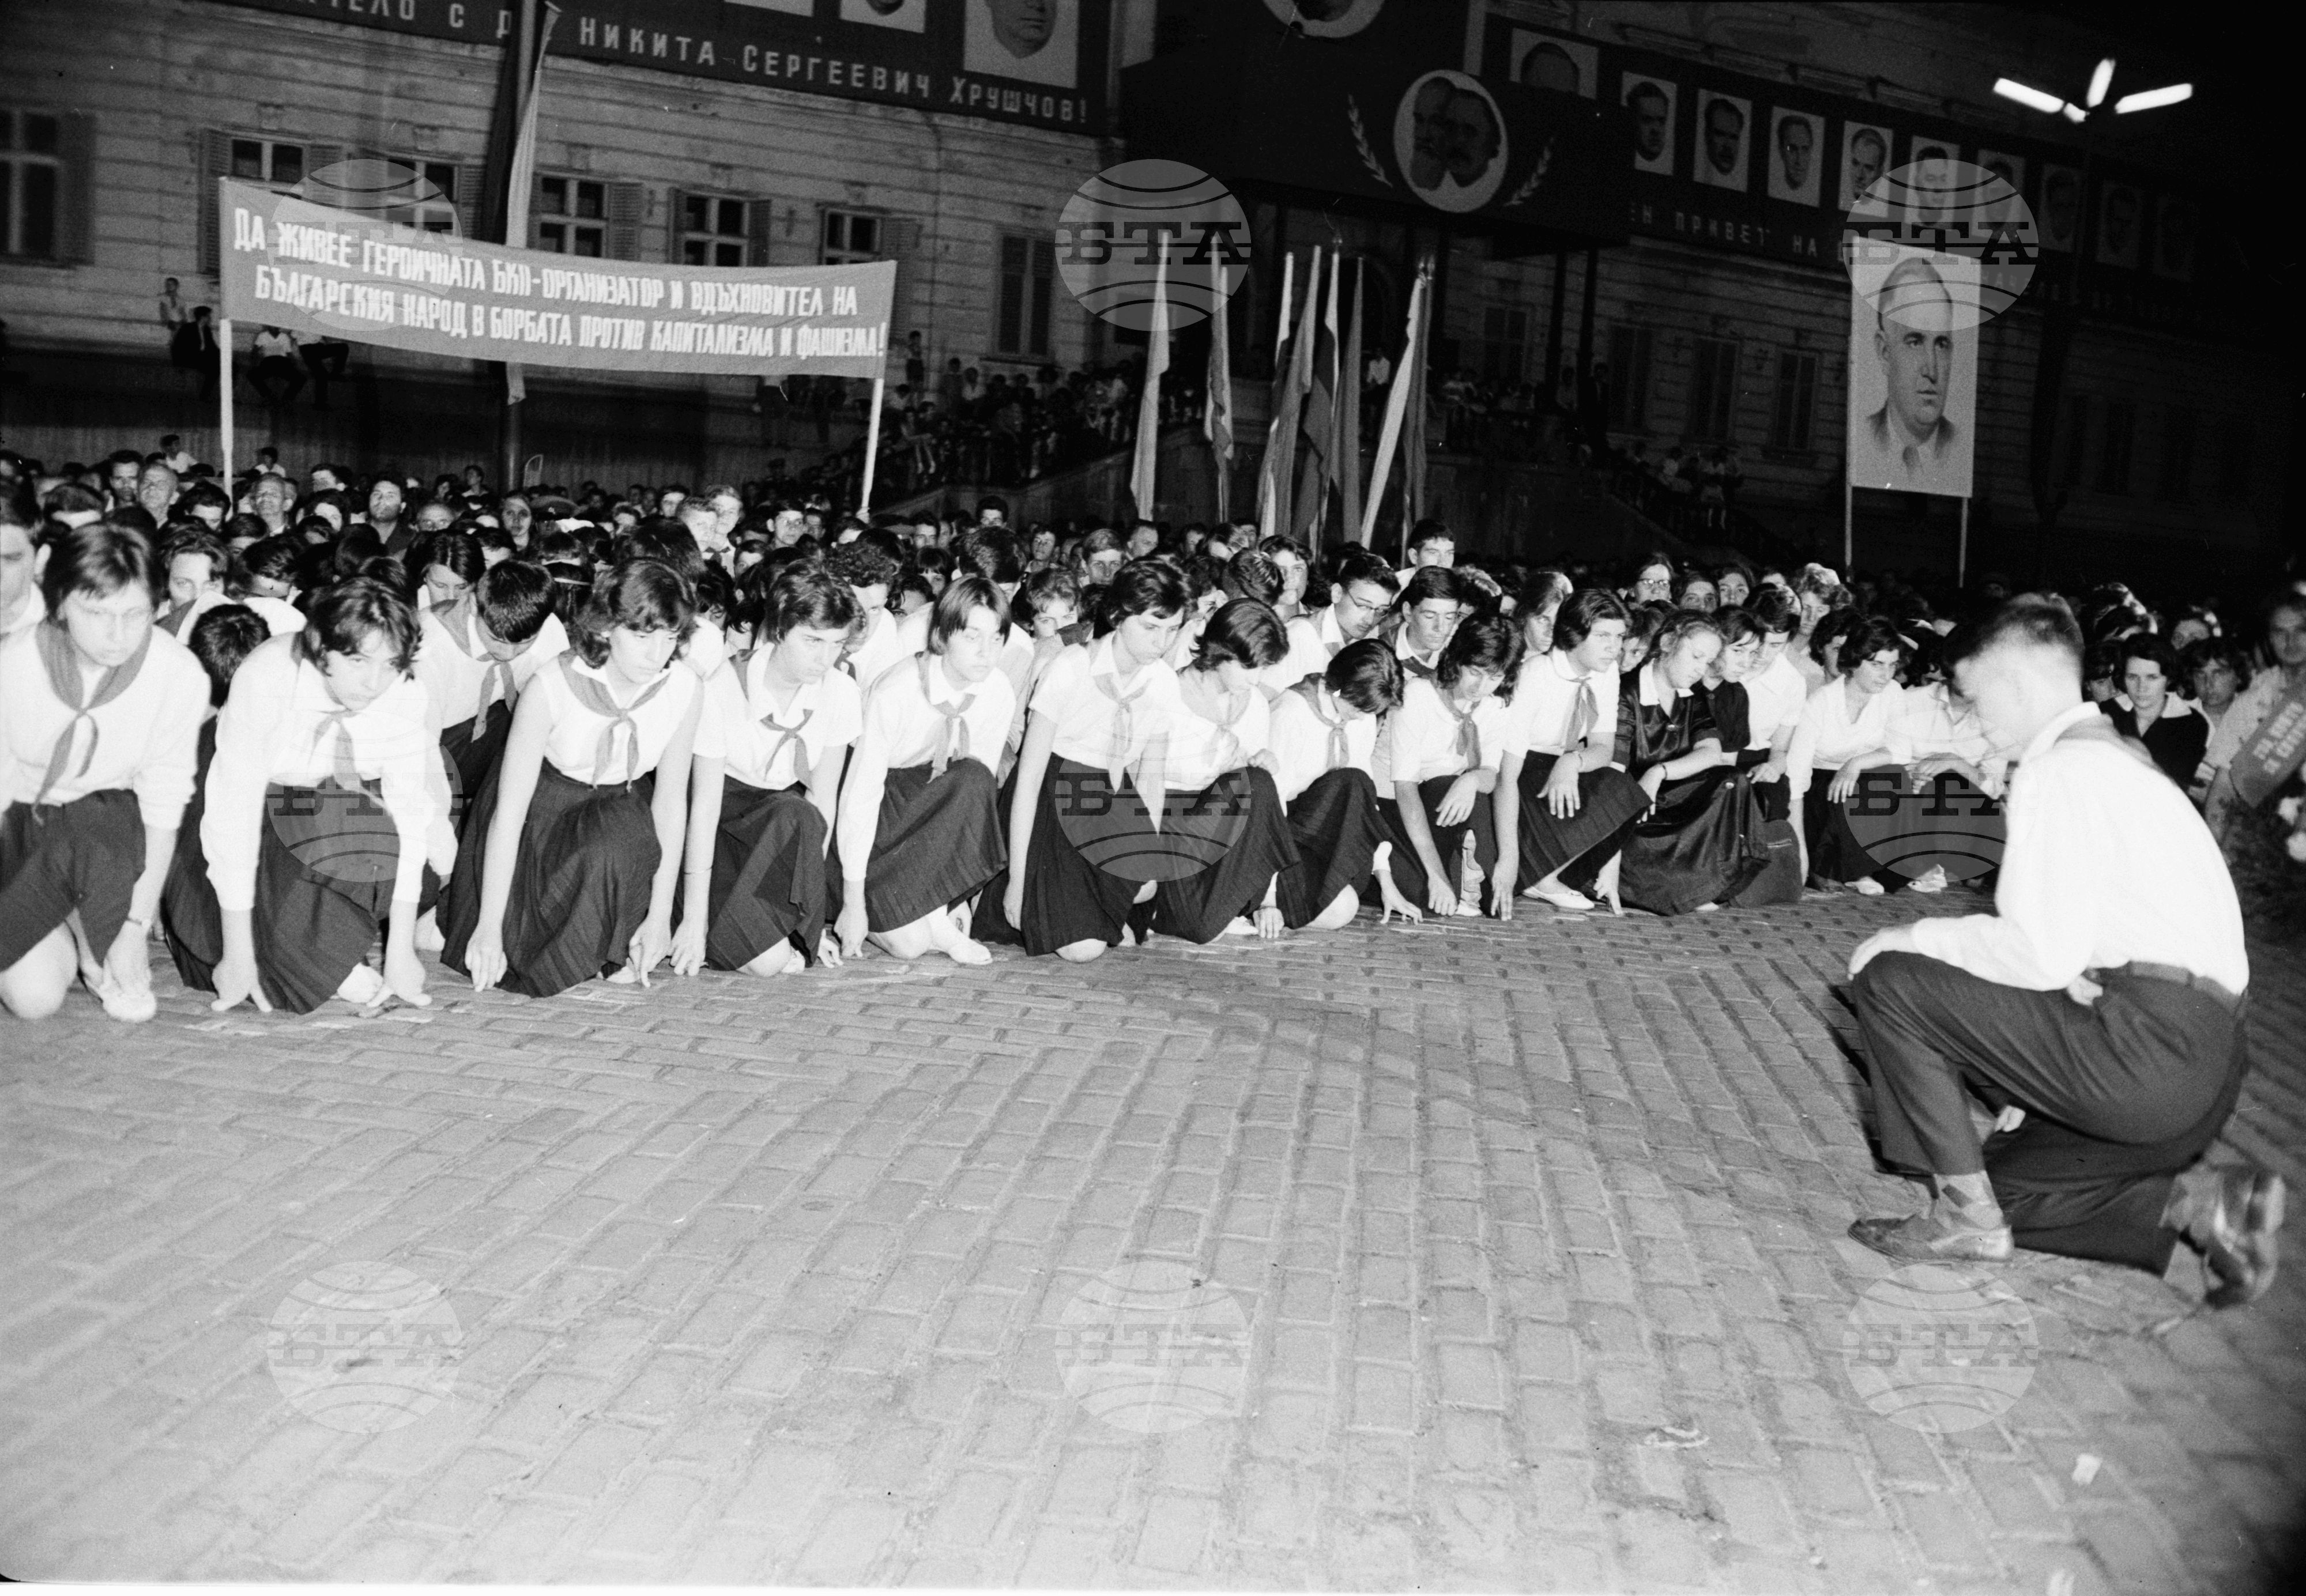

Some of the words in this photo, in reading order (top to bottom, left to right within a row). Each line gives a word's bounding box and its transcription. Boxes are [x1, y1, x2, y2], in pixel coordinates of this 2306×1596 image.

[450, 3, 464, 28] С
[580, 17, 715, 66] НИКИТА
[742, 44, 930, 98] СЕРГЕЕВИЧ
[950, 76, 1087, 123] ХРУШЧОВ!
[234, 208, 265, 251] ДА
[277, 222, 352, 267] ЖИВЕЕ
[363, 239, 485, 290] ГЕРОИЧНАТА
[670, 282, 683, 309] И
[691, 281, 823, 316] ВДЪХНОВИТЕЛ
[832, 286, 857, 315] НА
[1675, 211, 1770, 246] ПРИВЕТ
[1792, 233, 1818, 258] НА
[255, 265, 394, 323] БЪЛГАРСКИЯ
[403, 295, 467, 339] НАРОД
[472, 305, 484, 337] В
[490, 307, 572, 346] БОРБАТА
[578, 315, 645, 350] ПРОТИВ
[650, 320, 774, 357] КАПИТАЛИЗМА
[780, 328, 792, 356] И
[797, 322, 887, 360] ФАШИЗМА!
